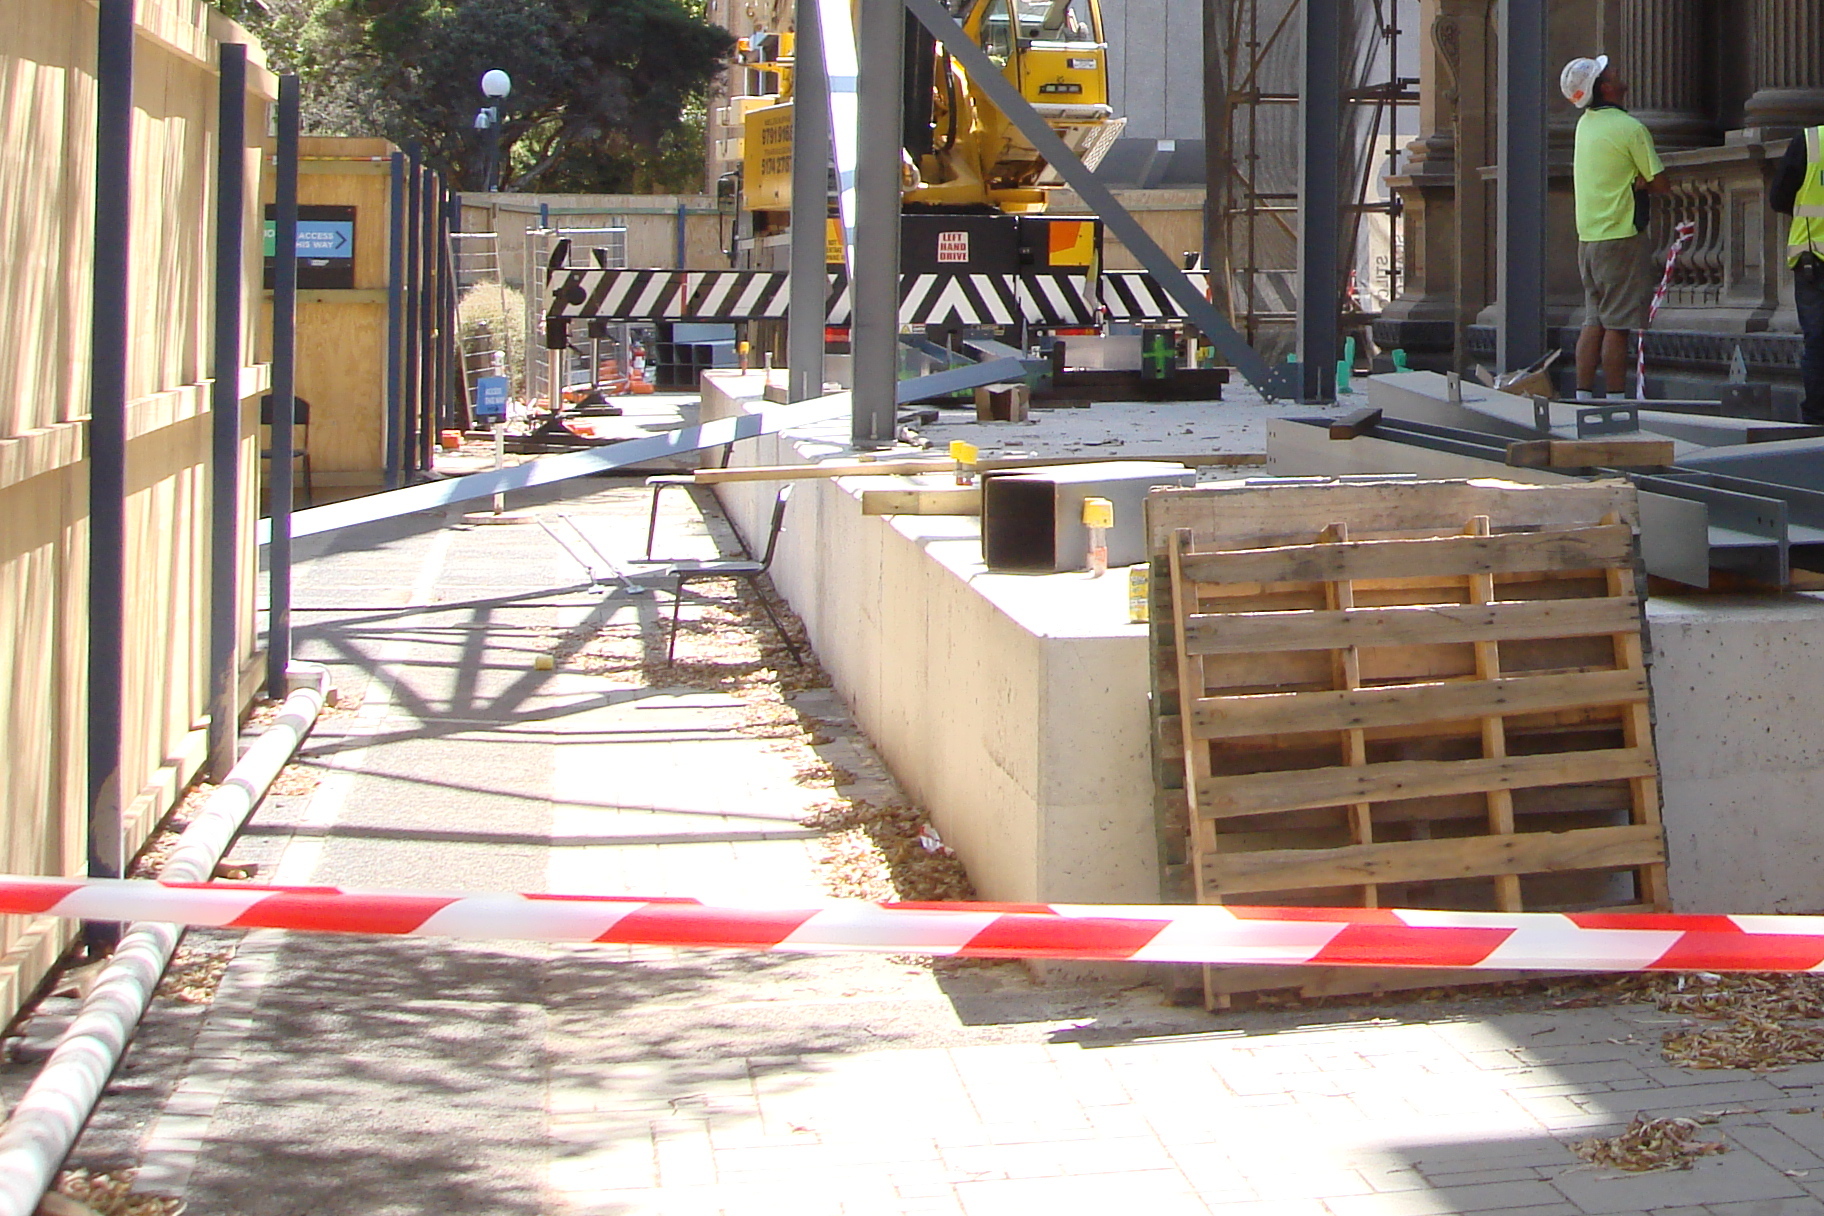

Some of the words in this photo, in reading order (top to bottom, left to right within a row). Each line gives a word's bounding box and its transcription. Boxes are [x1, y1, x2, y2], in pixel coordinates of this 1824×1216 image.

[298, 232, 334, 240] ACCESS
[943, 233, 963, 242] LEFT
[313, 241, 334, 249] WAY
[940, 242, 967, 251] HAND
[939, 252, 967, 261] DRIVE
